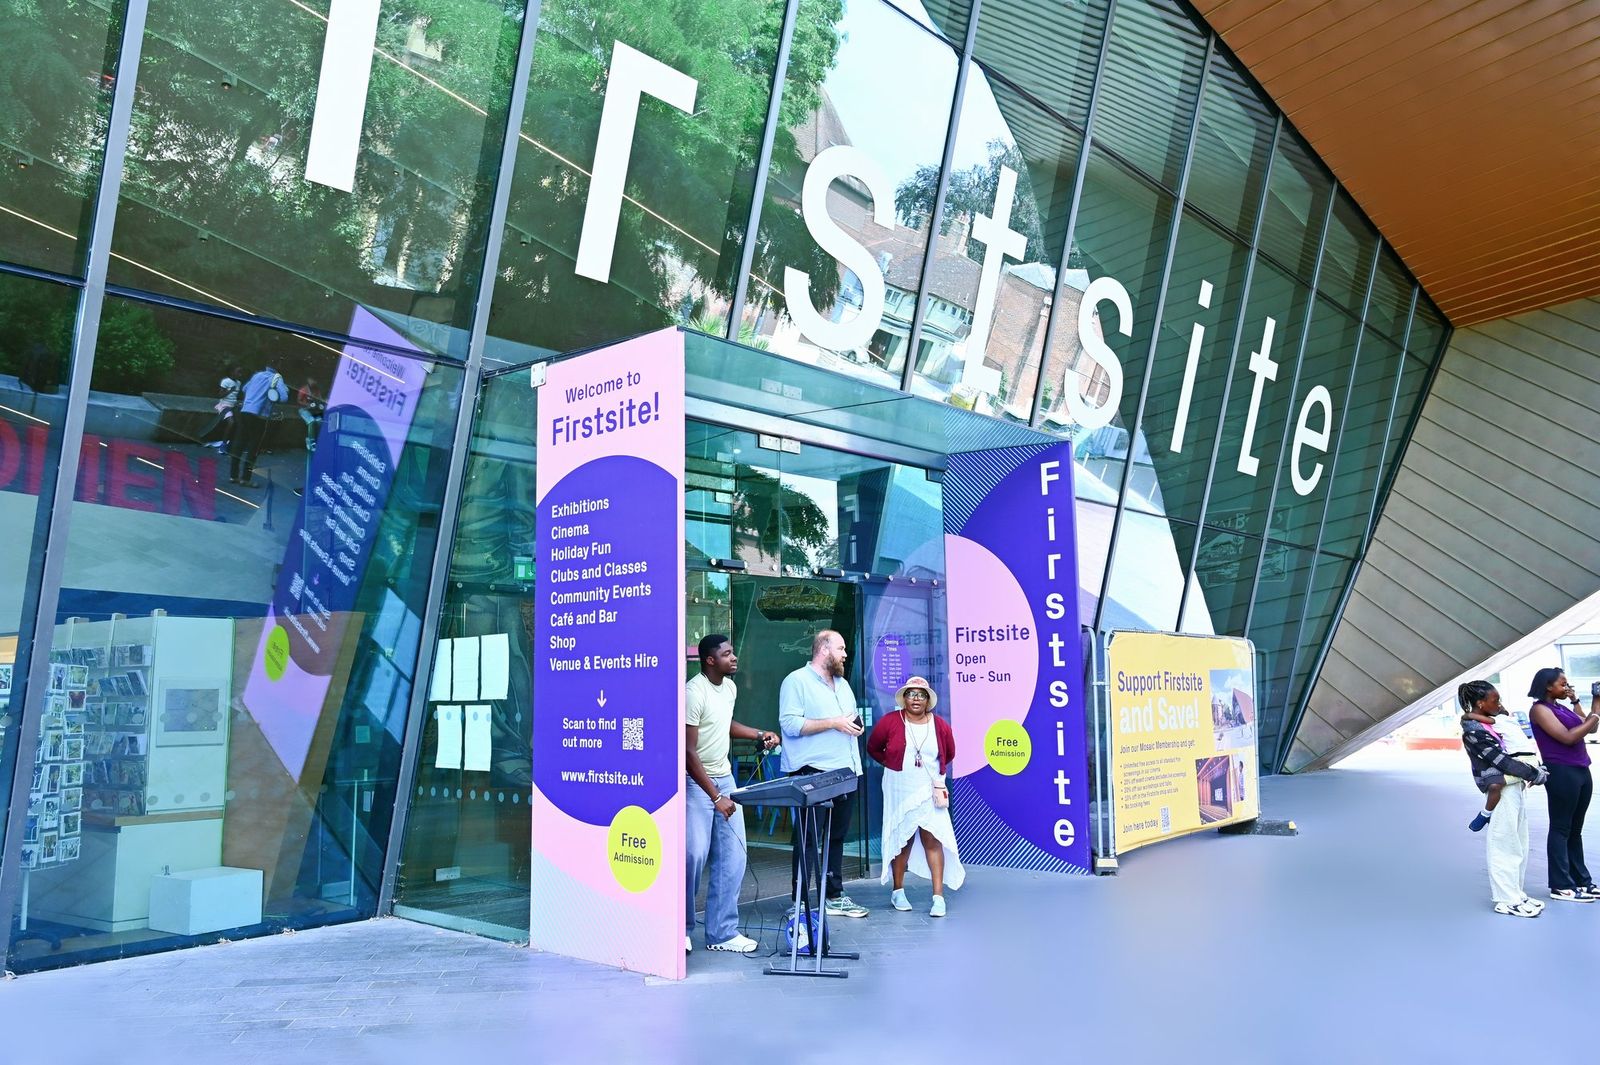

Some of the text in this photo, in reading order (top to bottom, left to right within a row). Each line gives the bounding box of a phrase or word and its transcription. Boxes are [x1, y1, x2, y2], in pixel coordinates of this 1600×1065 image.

[565, 371, 641, 404] Welcome to
[552, 392, 660, 446] Firstsite!
[551, 498, 610, 518] Exhibitions
[551, 524, 589, 540] Cinema
[551, 542, 611, 561] Holiday Fun
[551, 561, 647, 583] Clubs and Classes
[550, 582, 651, 605] Community Events
[550, 609, 618, 627] Café and Bar
[955, 624, 1030, 643] Firstsite
[549, 635, 576, 651] Shop
[549, 653, 658, 671] Venue & Events Hire
[955, 653, 986, 666] Open
[1039, 460, 1075, 847] Firstsite
[956, 671, 976, 683] Tue
[988, 670, 1011, 682] Sun
[1118, 671, 1203, 696] Support Firstsite
[562, 717, 617, 731] Scan to find
[1119, 697, 1199, 734] and Save!
[562, 737, 602, 749] out more
[996, 737, 1018, 747] Free
[1120, 745, 1130, 754] Join
[1140, 743, 1155, 751] Mosaic
[1156, 740, 1180, 749] Membership
[990, 749, 1025, 758] Admission
[561, 769, 644, 786] www.firstsite.uk
[1123, 825, 1133, 834] Join
[1145, 820, 1158, 828] today
[621, 832, 647, 849] Free
[613, 852, 655, 867] Admission
